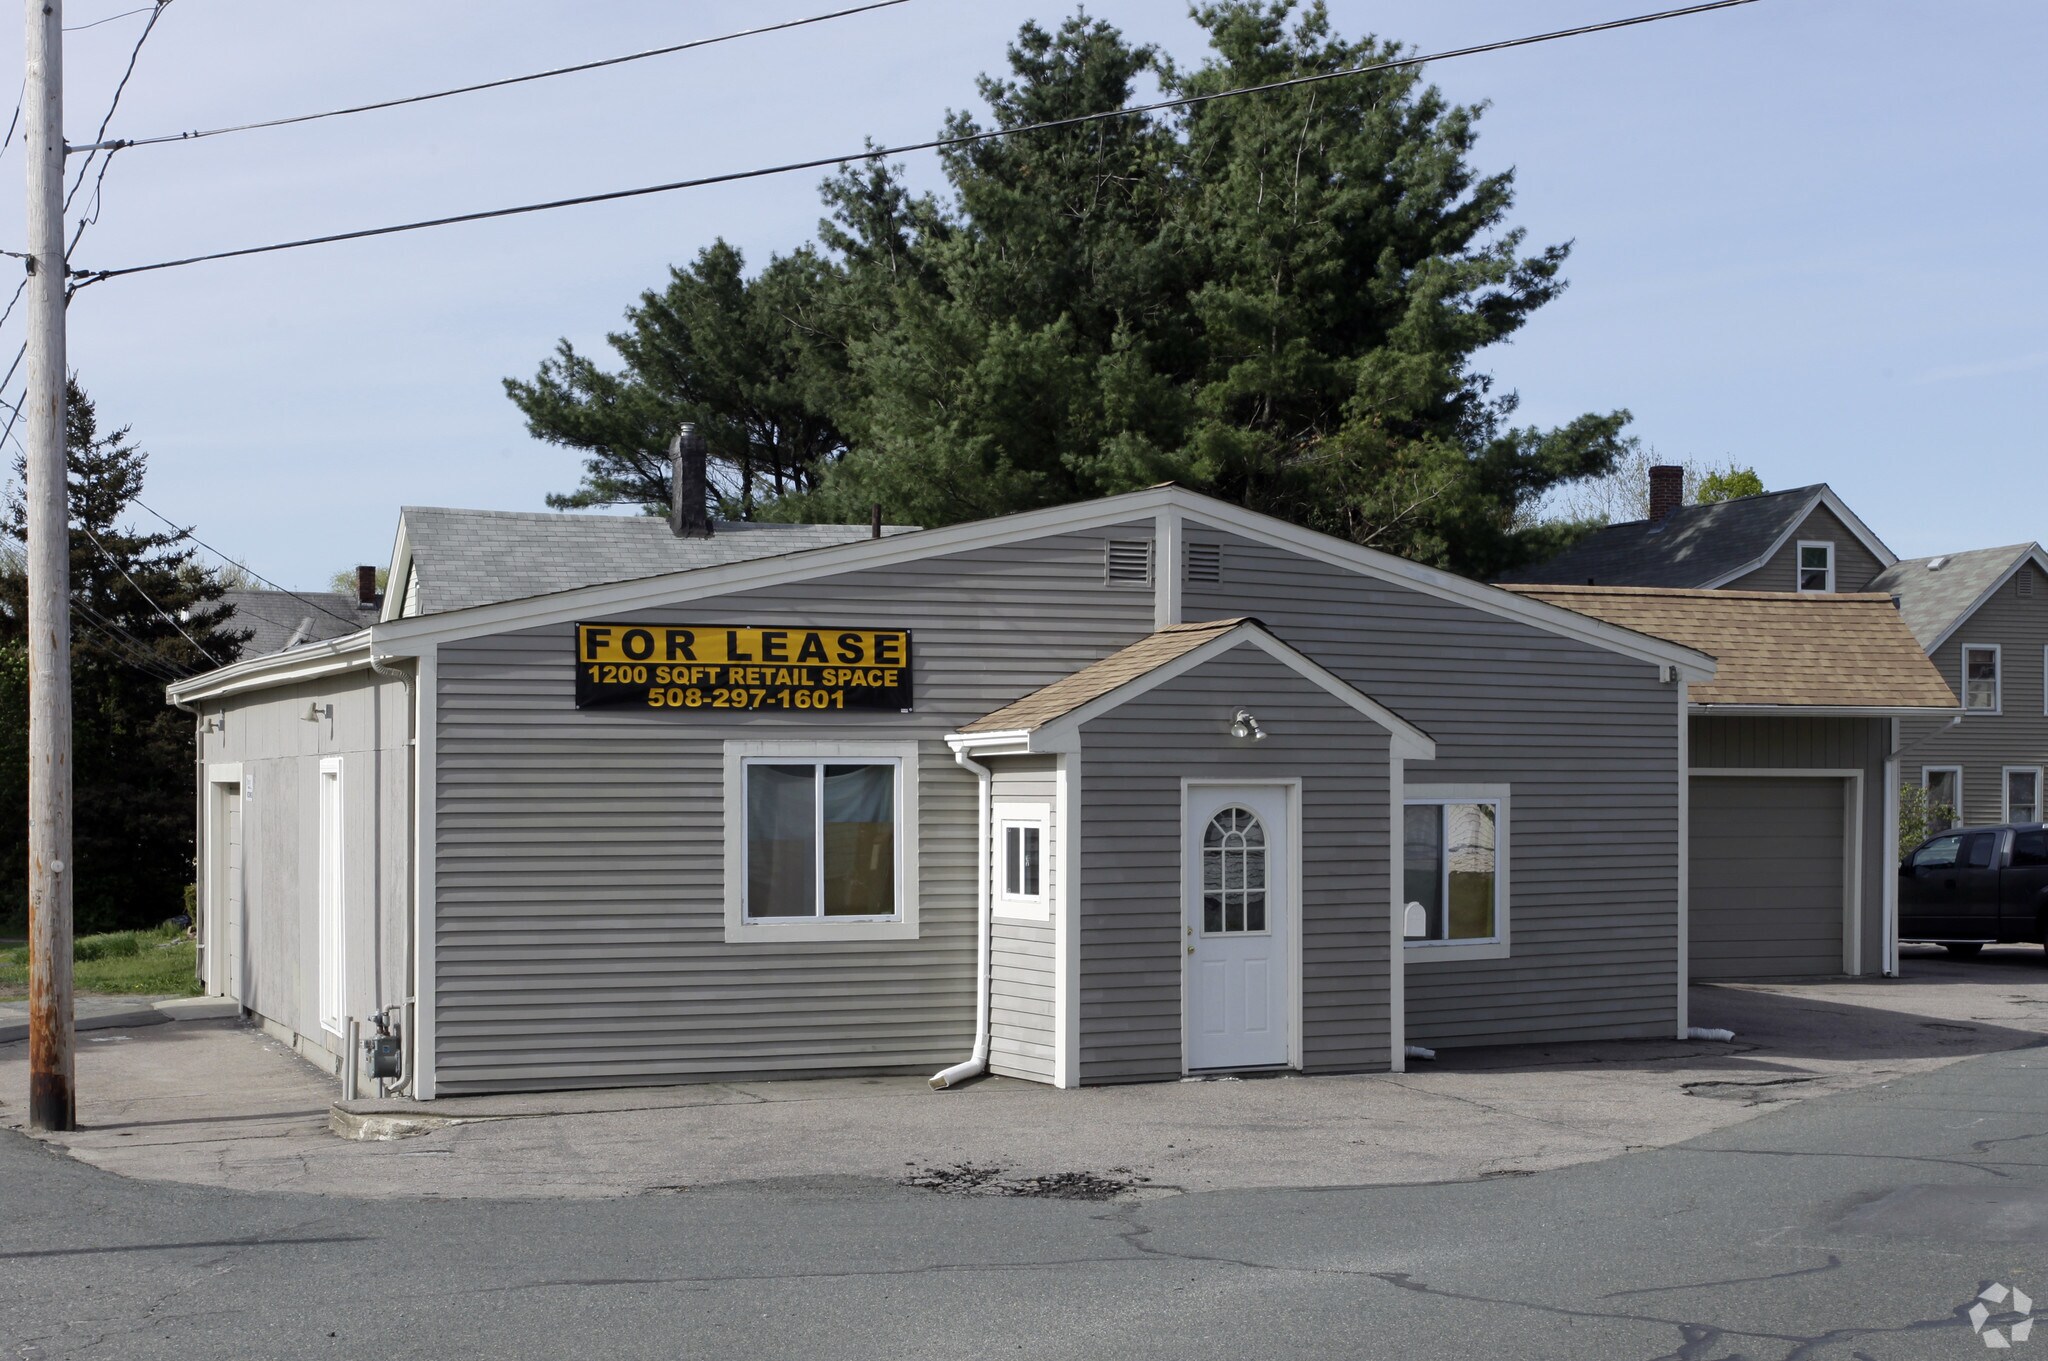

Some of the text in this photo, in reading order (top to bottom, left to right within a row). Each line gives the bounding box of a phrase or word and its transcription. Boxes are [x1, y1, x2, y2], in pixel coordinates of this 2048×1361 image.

[586, 628, 900, 664] FOR LEASE
[588, 665, 898, 687] 1200 SQFT RETAIL SPACE
[648, 687, 844, 708] 508-297-1601
